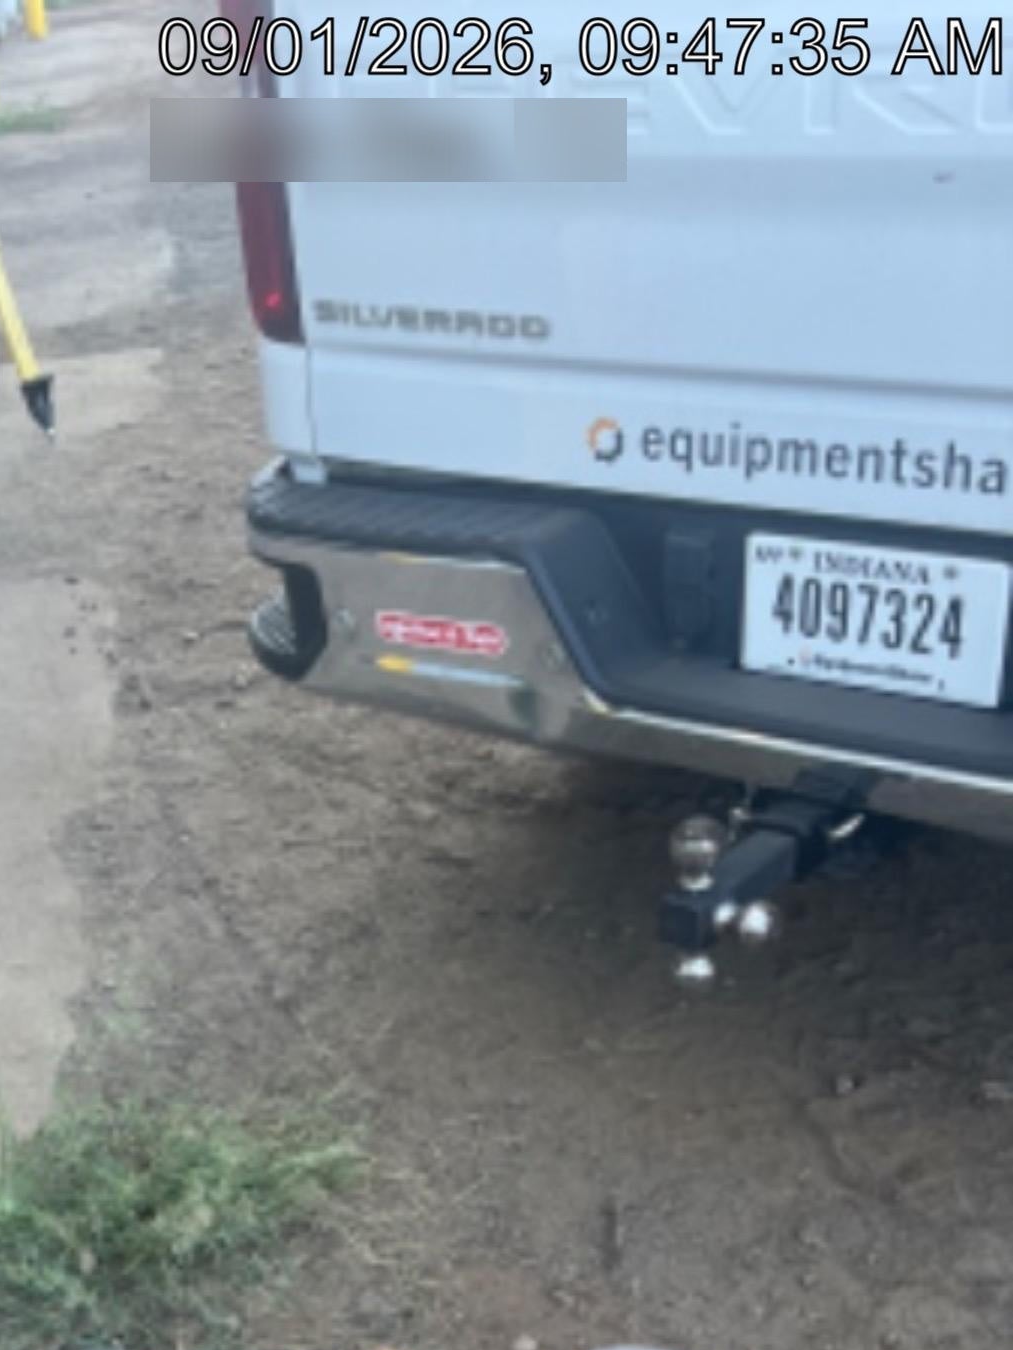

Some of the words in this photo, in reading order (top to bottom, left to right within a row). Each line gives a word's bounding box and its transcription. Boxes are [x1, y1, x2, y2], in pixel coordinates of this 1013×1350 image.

[312, 299, 551, 339] SILVERADO
[640, 421, 1007, 496] equipmentsha
[814, 551, 930, 586] INDIANA
[772, 572, 965, 661] 4097324
